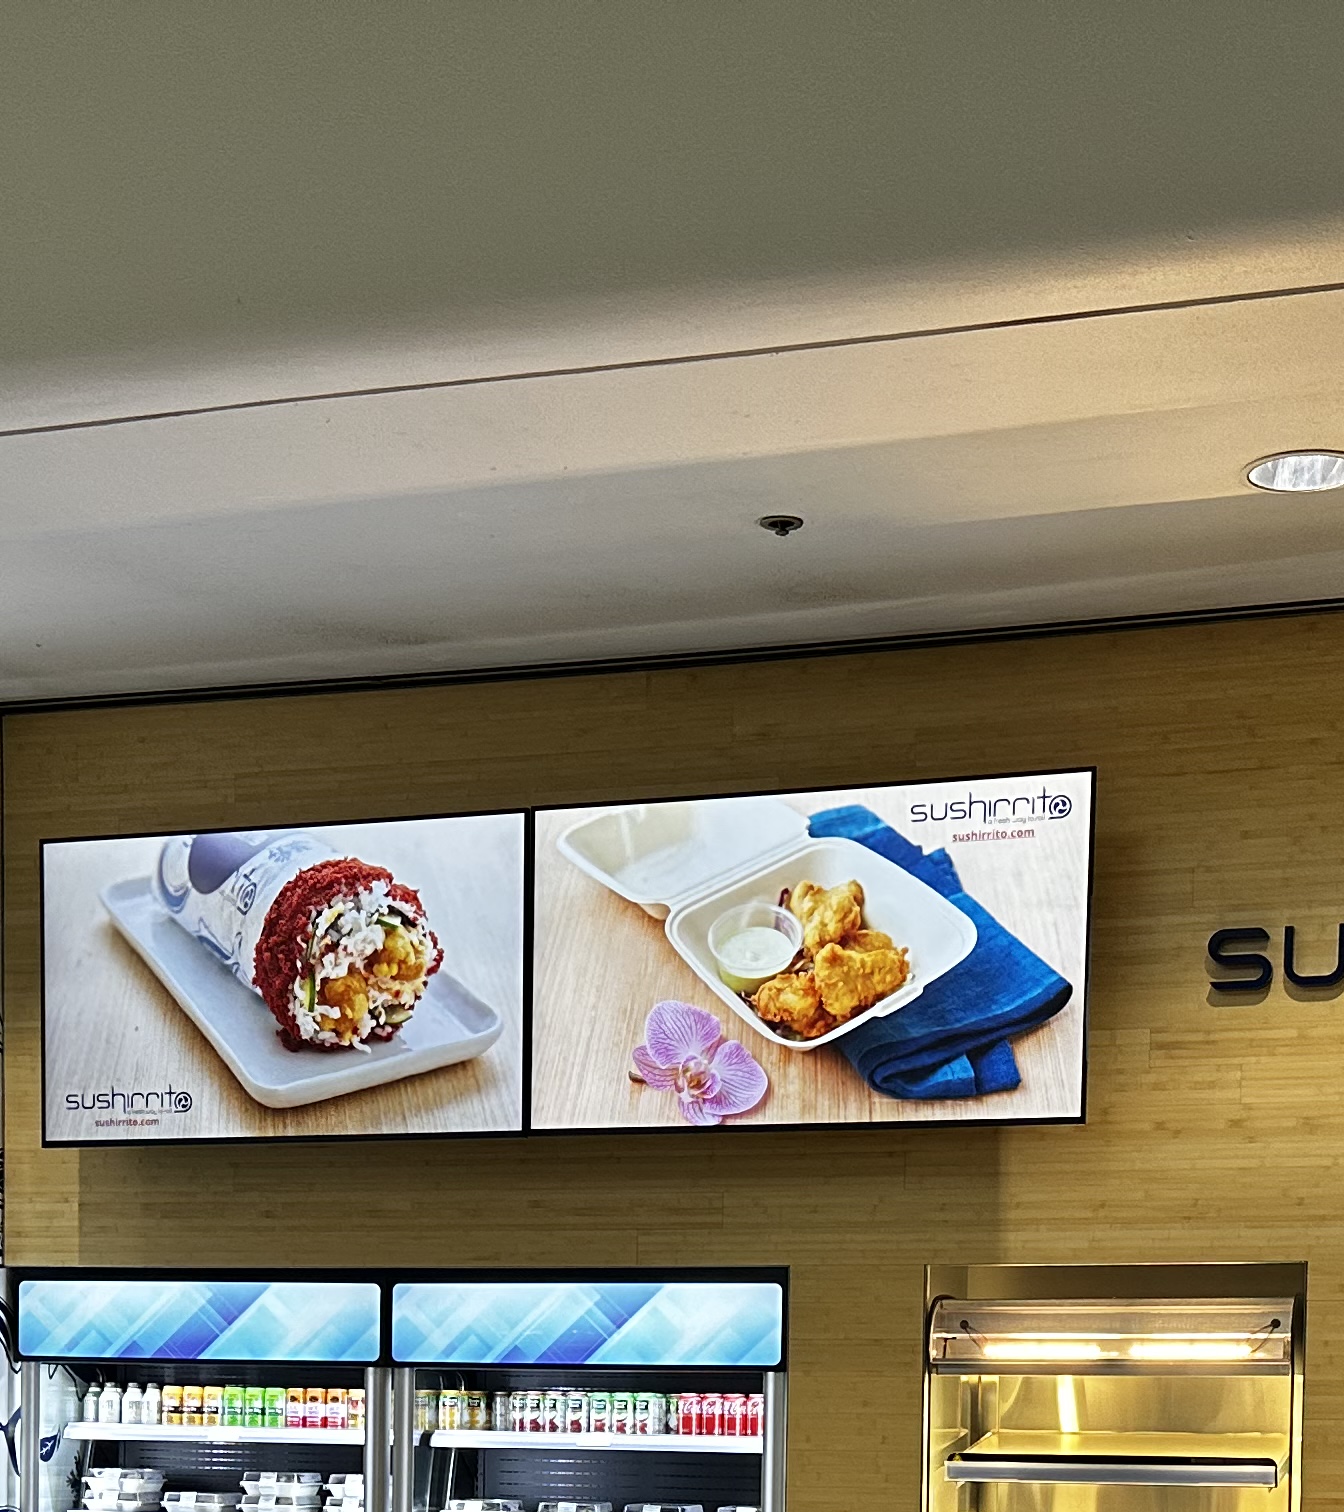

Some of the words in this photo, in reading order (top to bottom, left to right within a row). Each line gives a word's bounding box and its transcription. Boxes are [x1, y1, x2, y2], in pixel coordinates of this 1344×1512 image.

[910, 786, 1072, 824] sushirrito
[952, 828, 1035, 842] sushirrito.com
[66, 1084, 192, 1114] sushirrito
[95, 1118, 159, 1127] sushirrito.com
